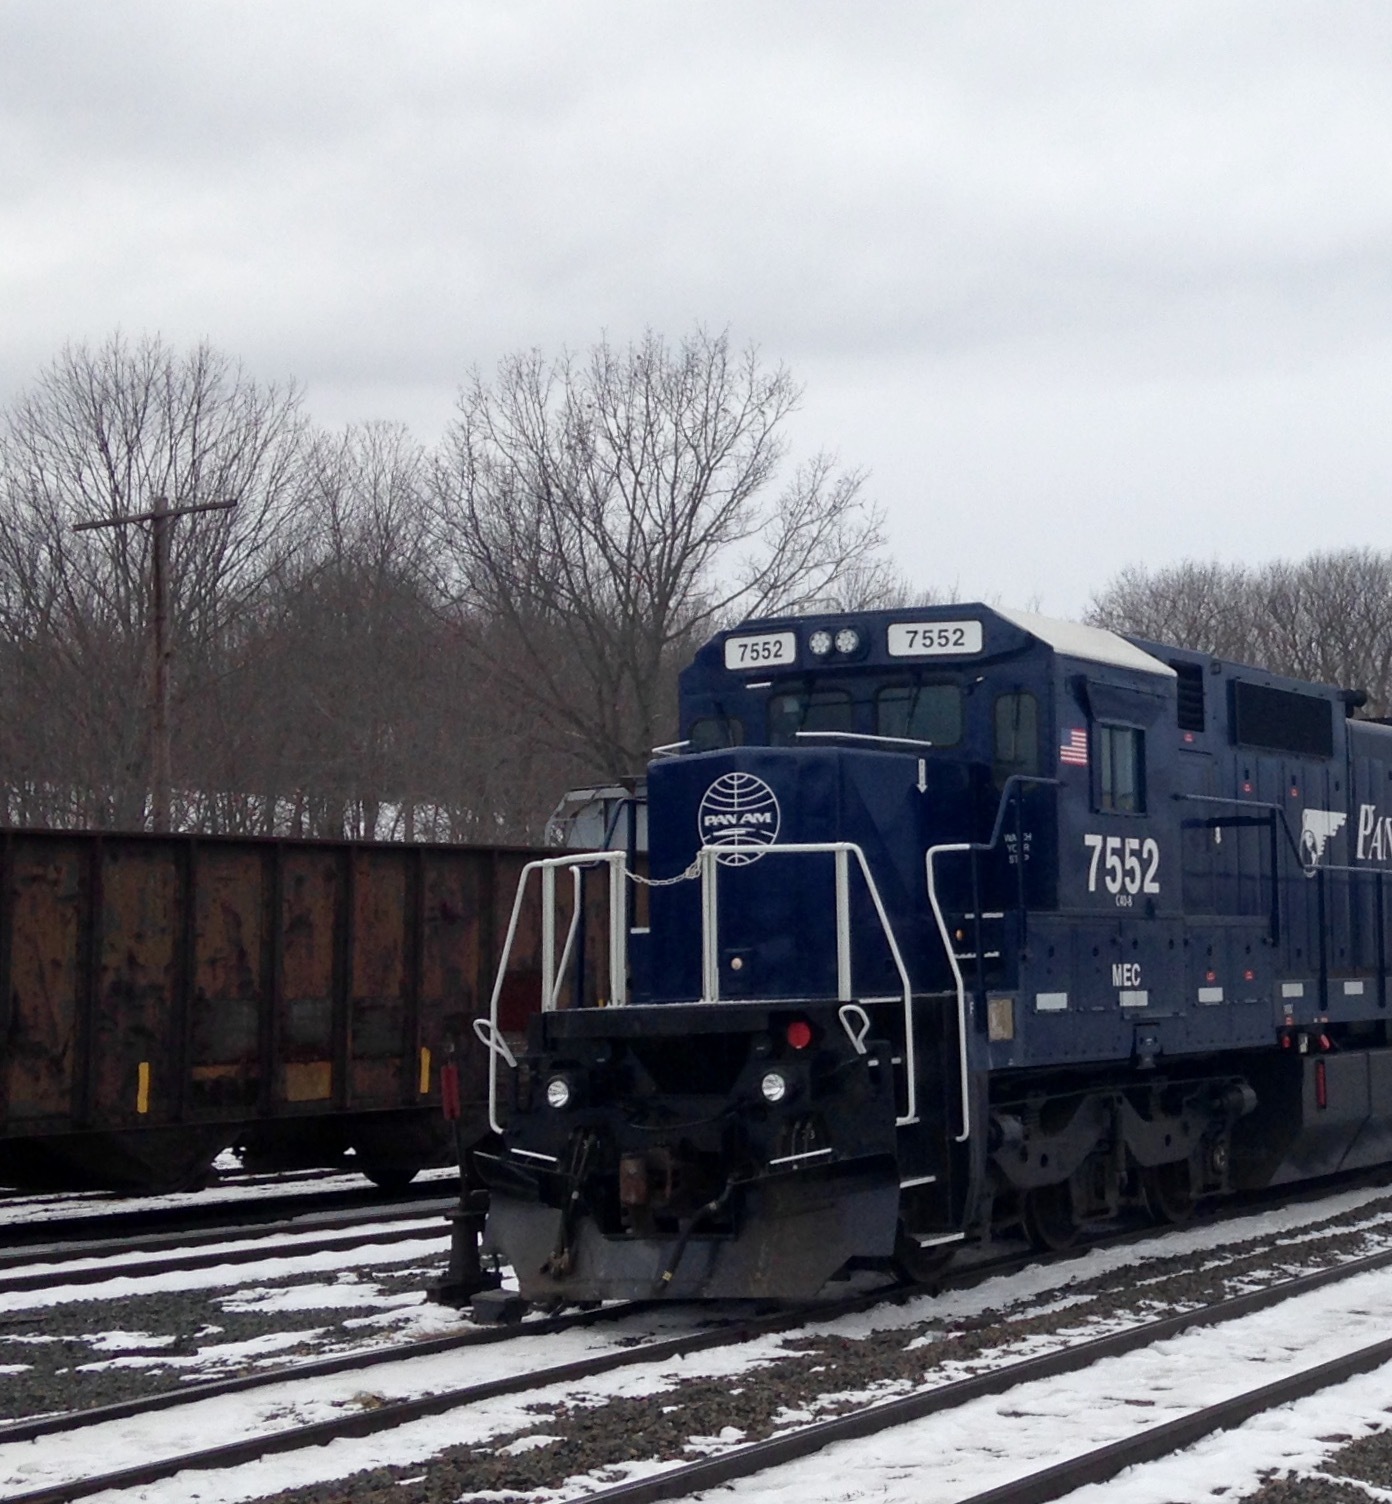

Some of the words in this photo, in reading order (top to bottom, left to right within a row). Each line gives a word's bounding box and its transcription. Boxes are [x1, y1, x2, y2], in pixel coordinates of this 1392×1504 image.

[905, 628, 965, 648] 7552
[738, 640, 783, 662] 7552
[704, 814, 737, 826] PAN
[739, 812, 772, 824] AM
[1008, 854, 1030, 864] STP
[1084, 834, 1160, 894] 7552
[1112, 963, 1141, 987] MEC
